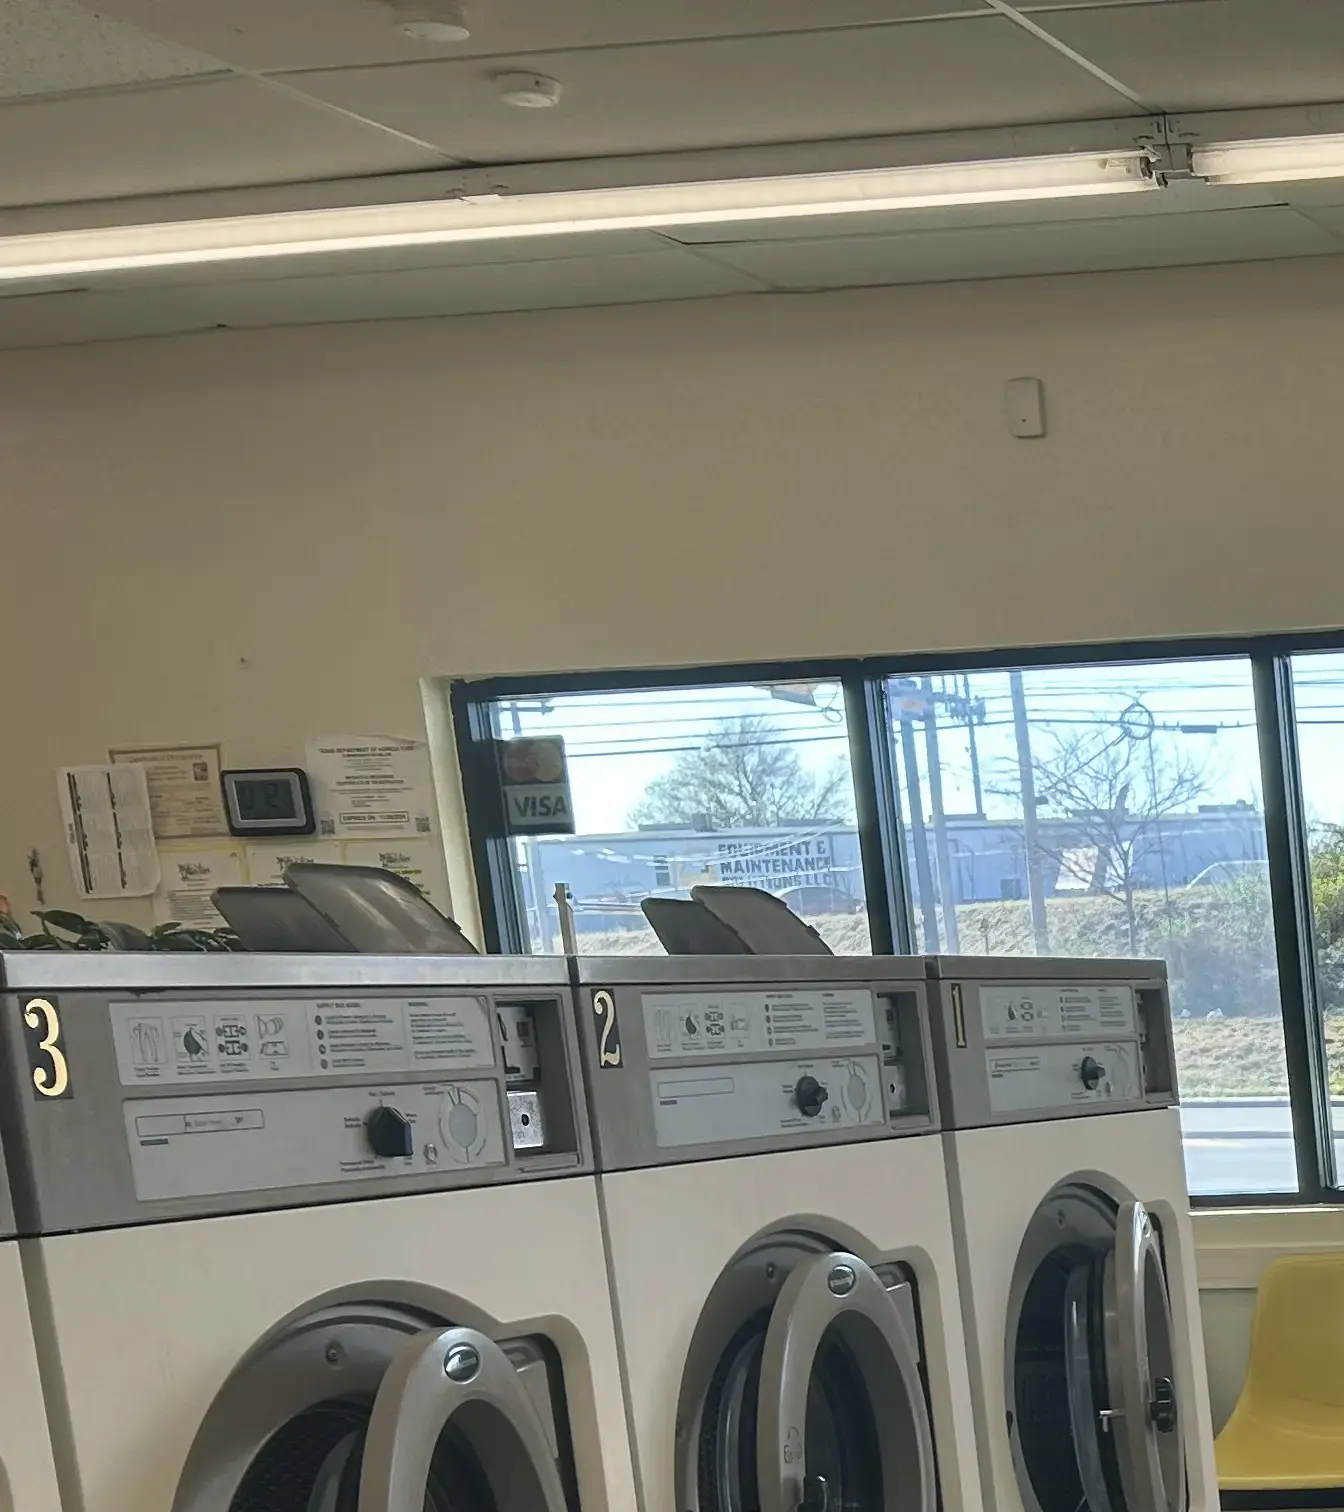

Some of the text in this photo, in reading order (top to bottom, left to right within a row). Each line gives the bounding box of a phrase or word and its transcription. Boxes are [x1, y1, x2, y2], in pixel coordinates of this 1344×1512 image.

[514, 795, 567, 818] VISA
[720, 856, 831, 874] MAINTENANCE
[25, 998, 67, 1096] 3
[594, 990, 620, 1066] 2
